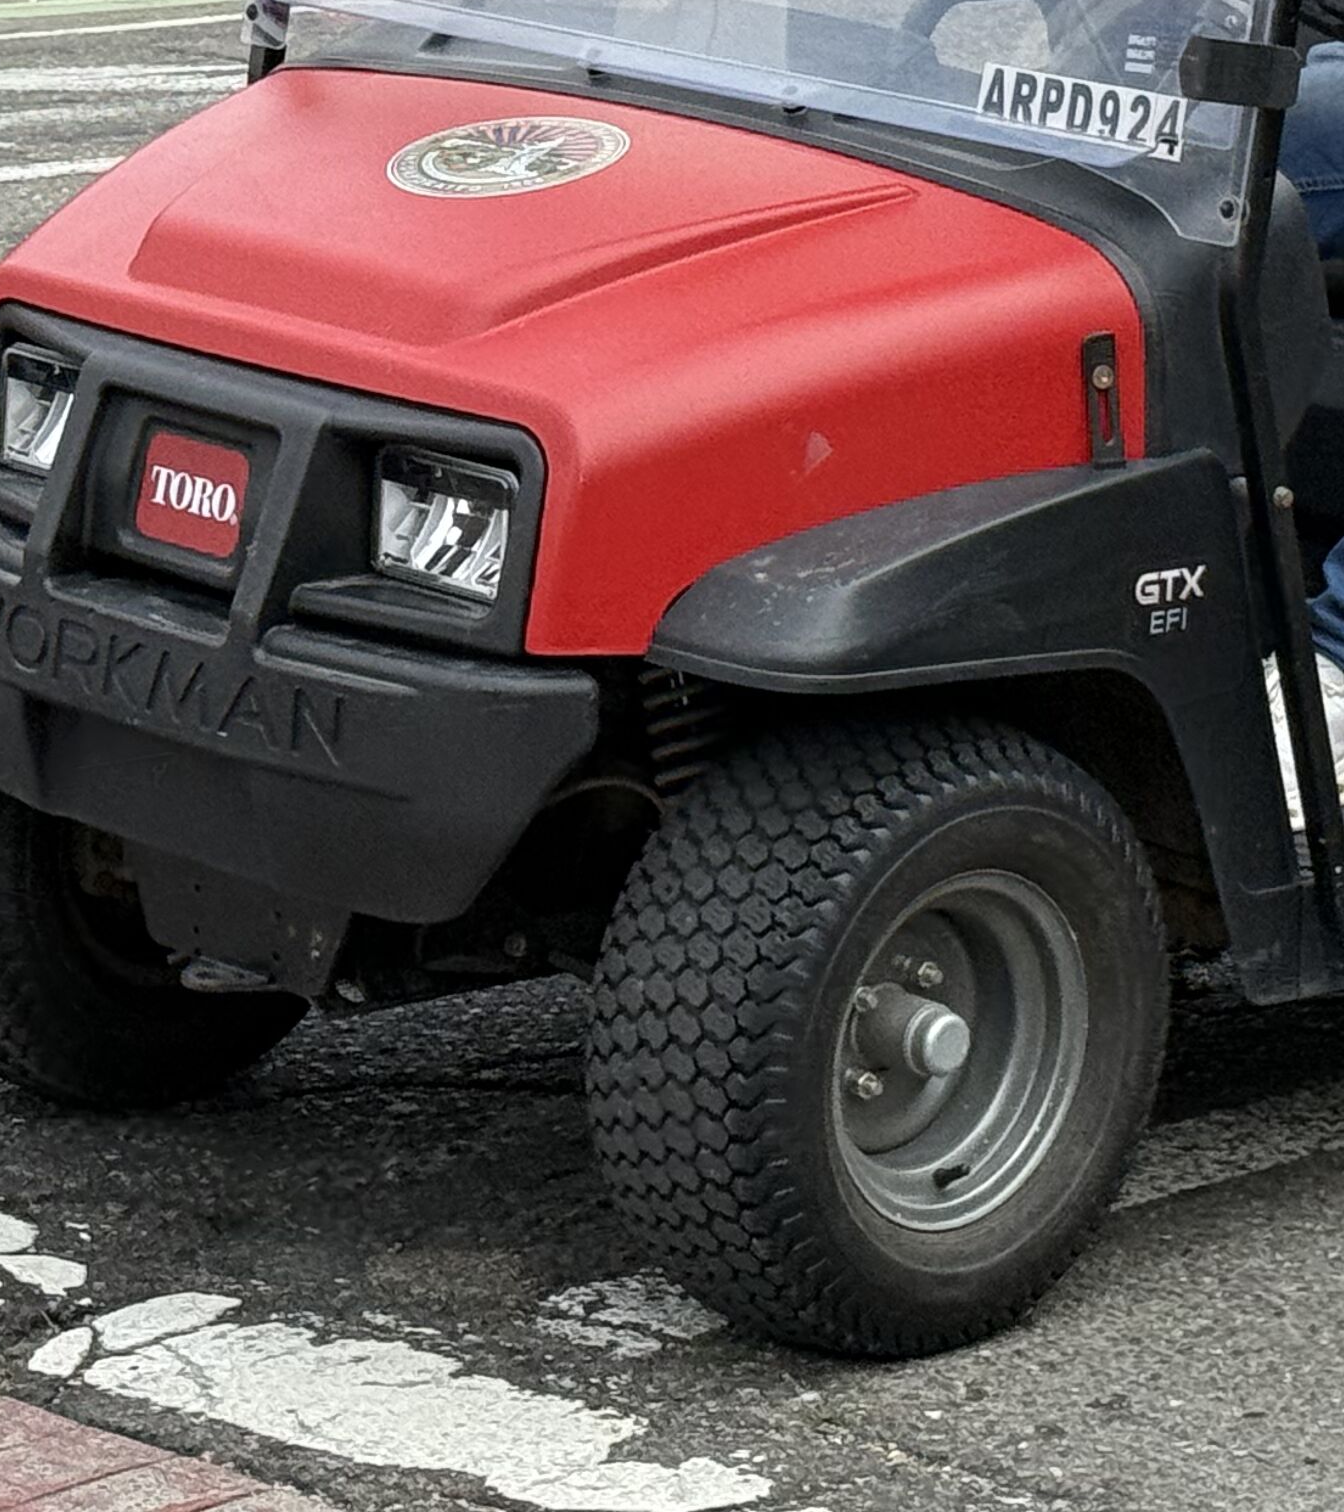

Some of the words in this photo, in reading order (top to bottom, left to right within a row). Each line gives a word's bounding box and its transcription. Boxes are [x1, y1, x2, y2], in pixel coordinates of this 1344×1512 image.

[982, 67, 1181, 156] ARPD924
[150, 465, 236, 523] TORO
[1135, 564, 1206, 605] GTX
[1150, 606, 1188, 635] EFI
